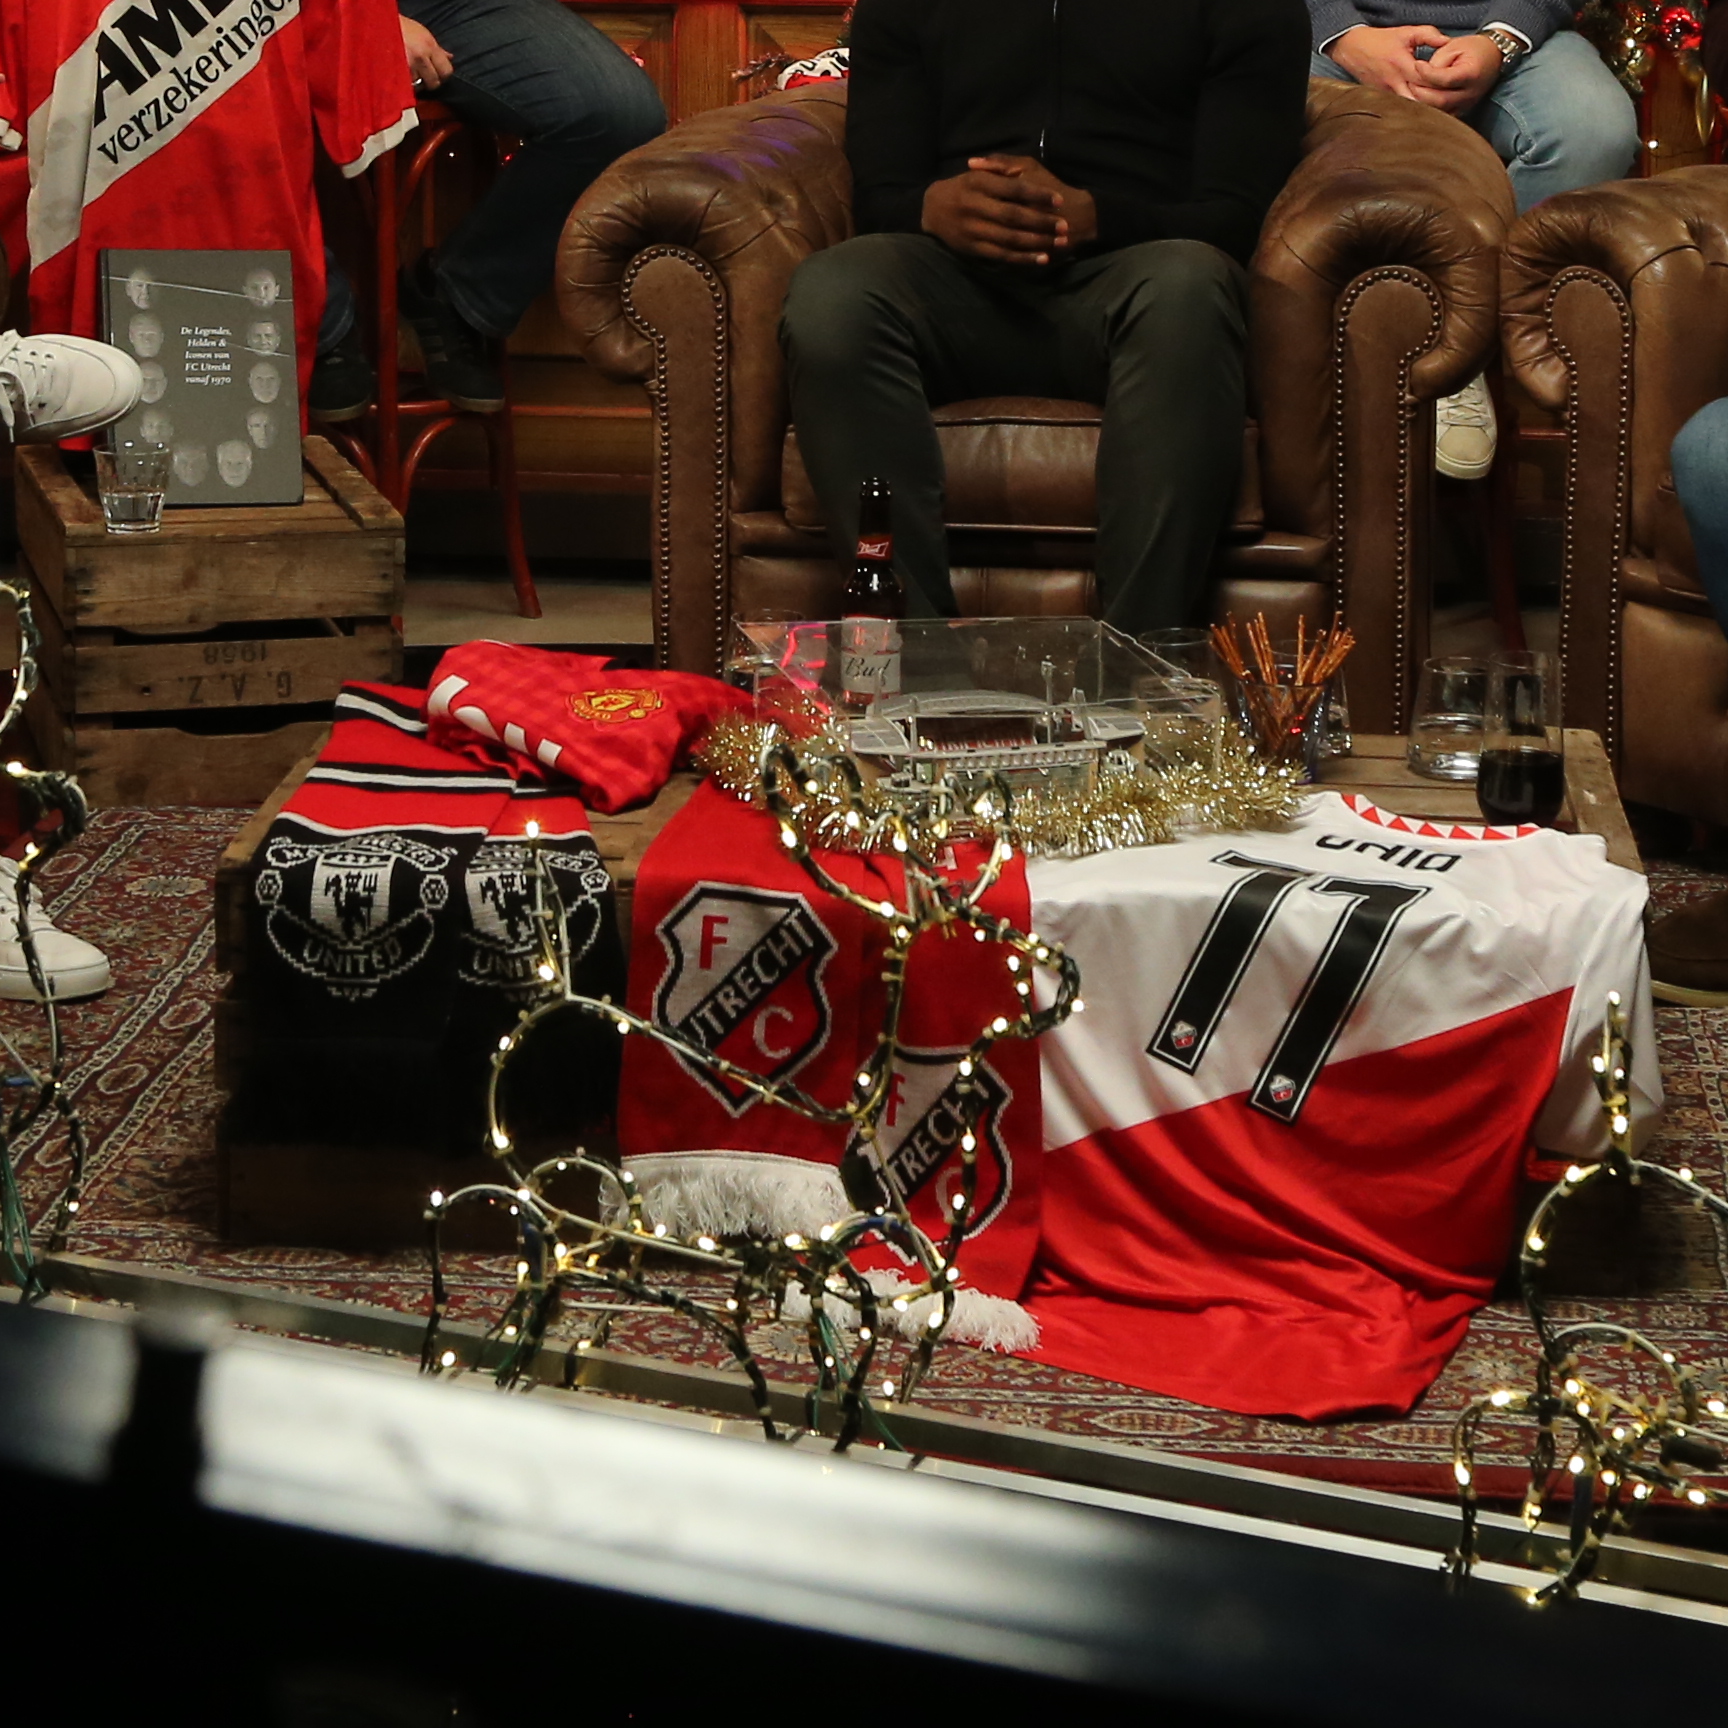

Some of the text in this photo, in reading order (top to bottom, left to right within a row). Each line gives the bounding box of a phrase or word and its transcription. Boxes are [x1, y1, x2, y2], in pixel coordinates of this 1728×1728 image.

[180, 326, 192, 336] De
[218, 337, 227, 348] &
[184, 362, 232, 372] FC Utrecht
[211, 376, 232, 386] 1970
[202, 642, 269, 665] 1958
[698, 914, 730, 970] F
[302, 934, 403, 976] UNITED
[751, 1005, 795, 1060] C
